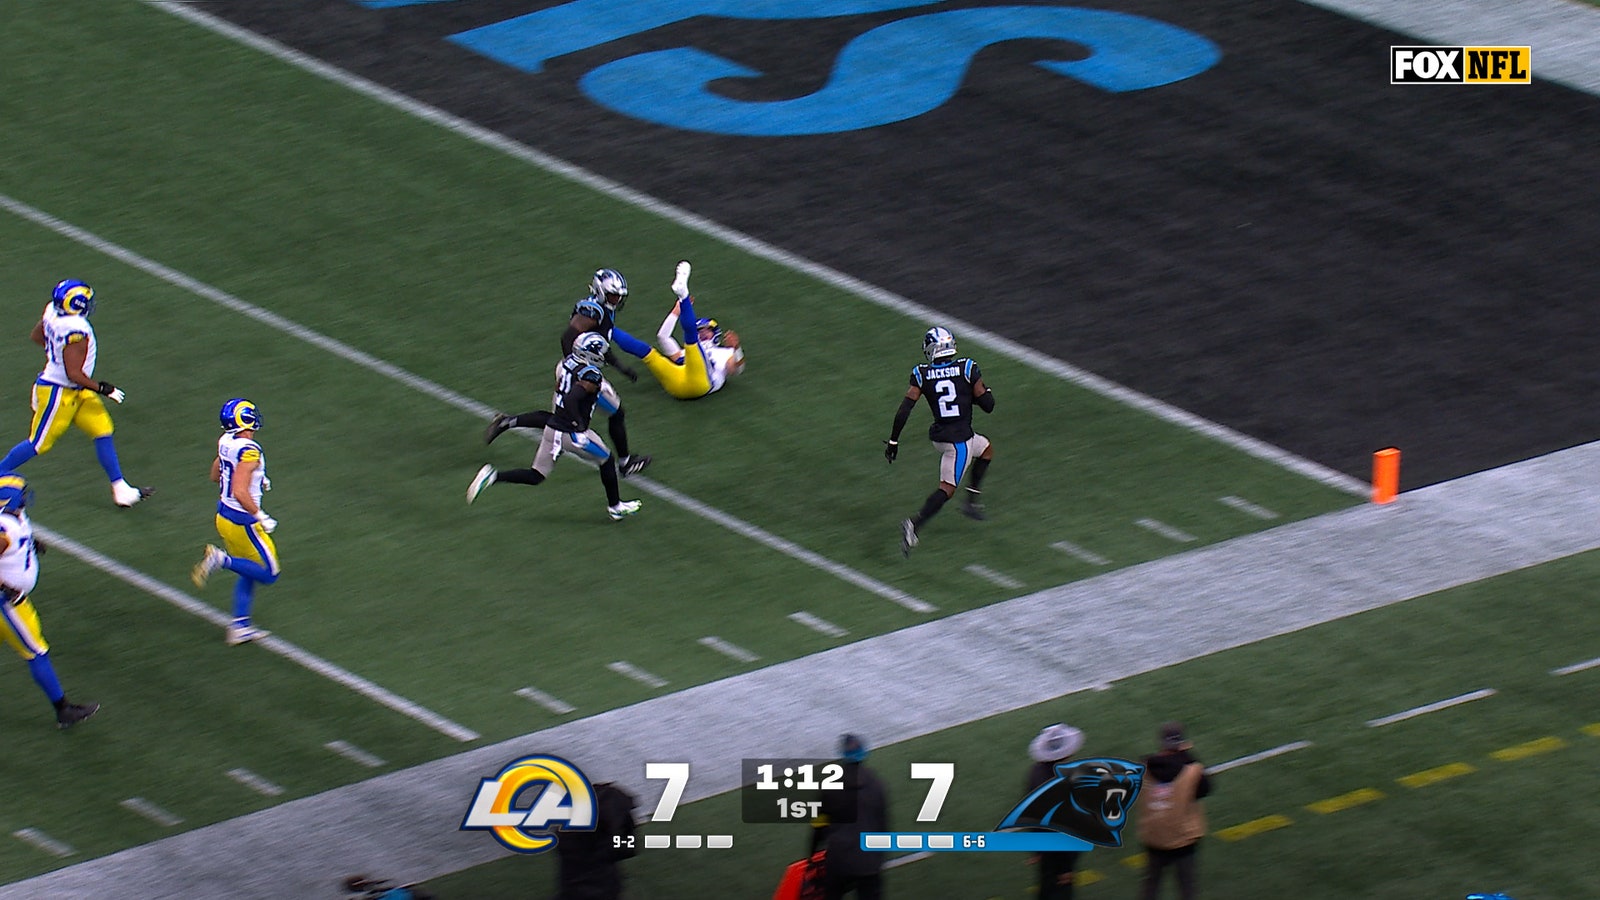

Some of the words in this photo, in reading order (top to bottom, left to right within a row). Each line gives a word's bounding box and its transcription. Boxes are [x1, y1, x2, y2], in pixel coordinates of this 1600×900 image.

[445, 0, 1221, 136] S
[925, 366, 961, 381] JACKSON
[935, 379, 961, 417] 2
